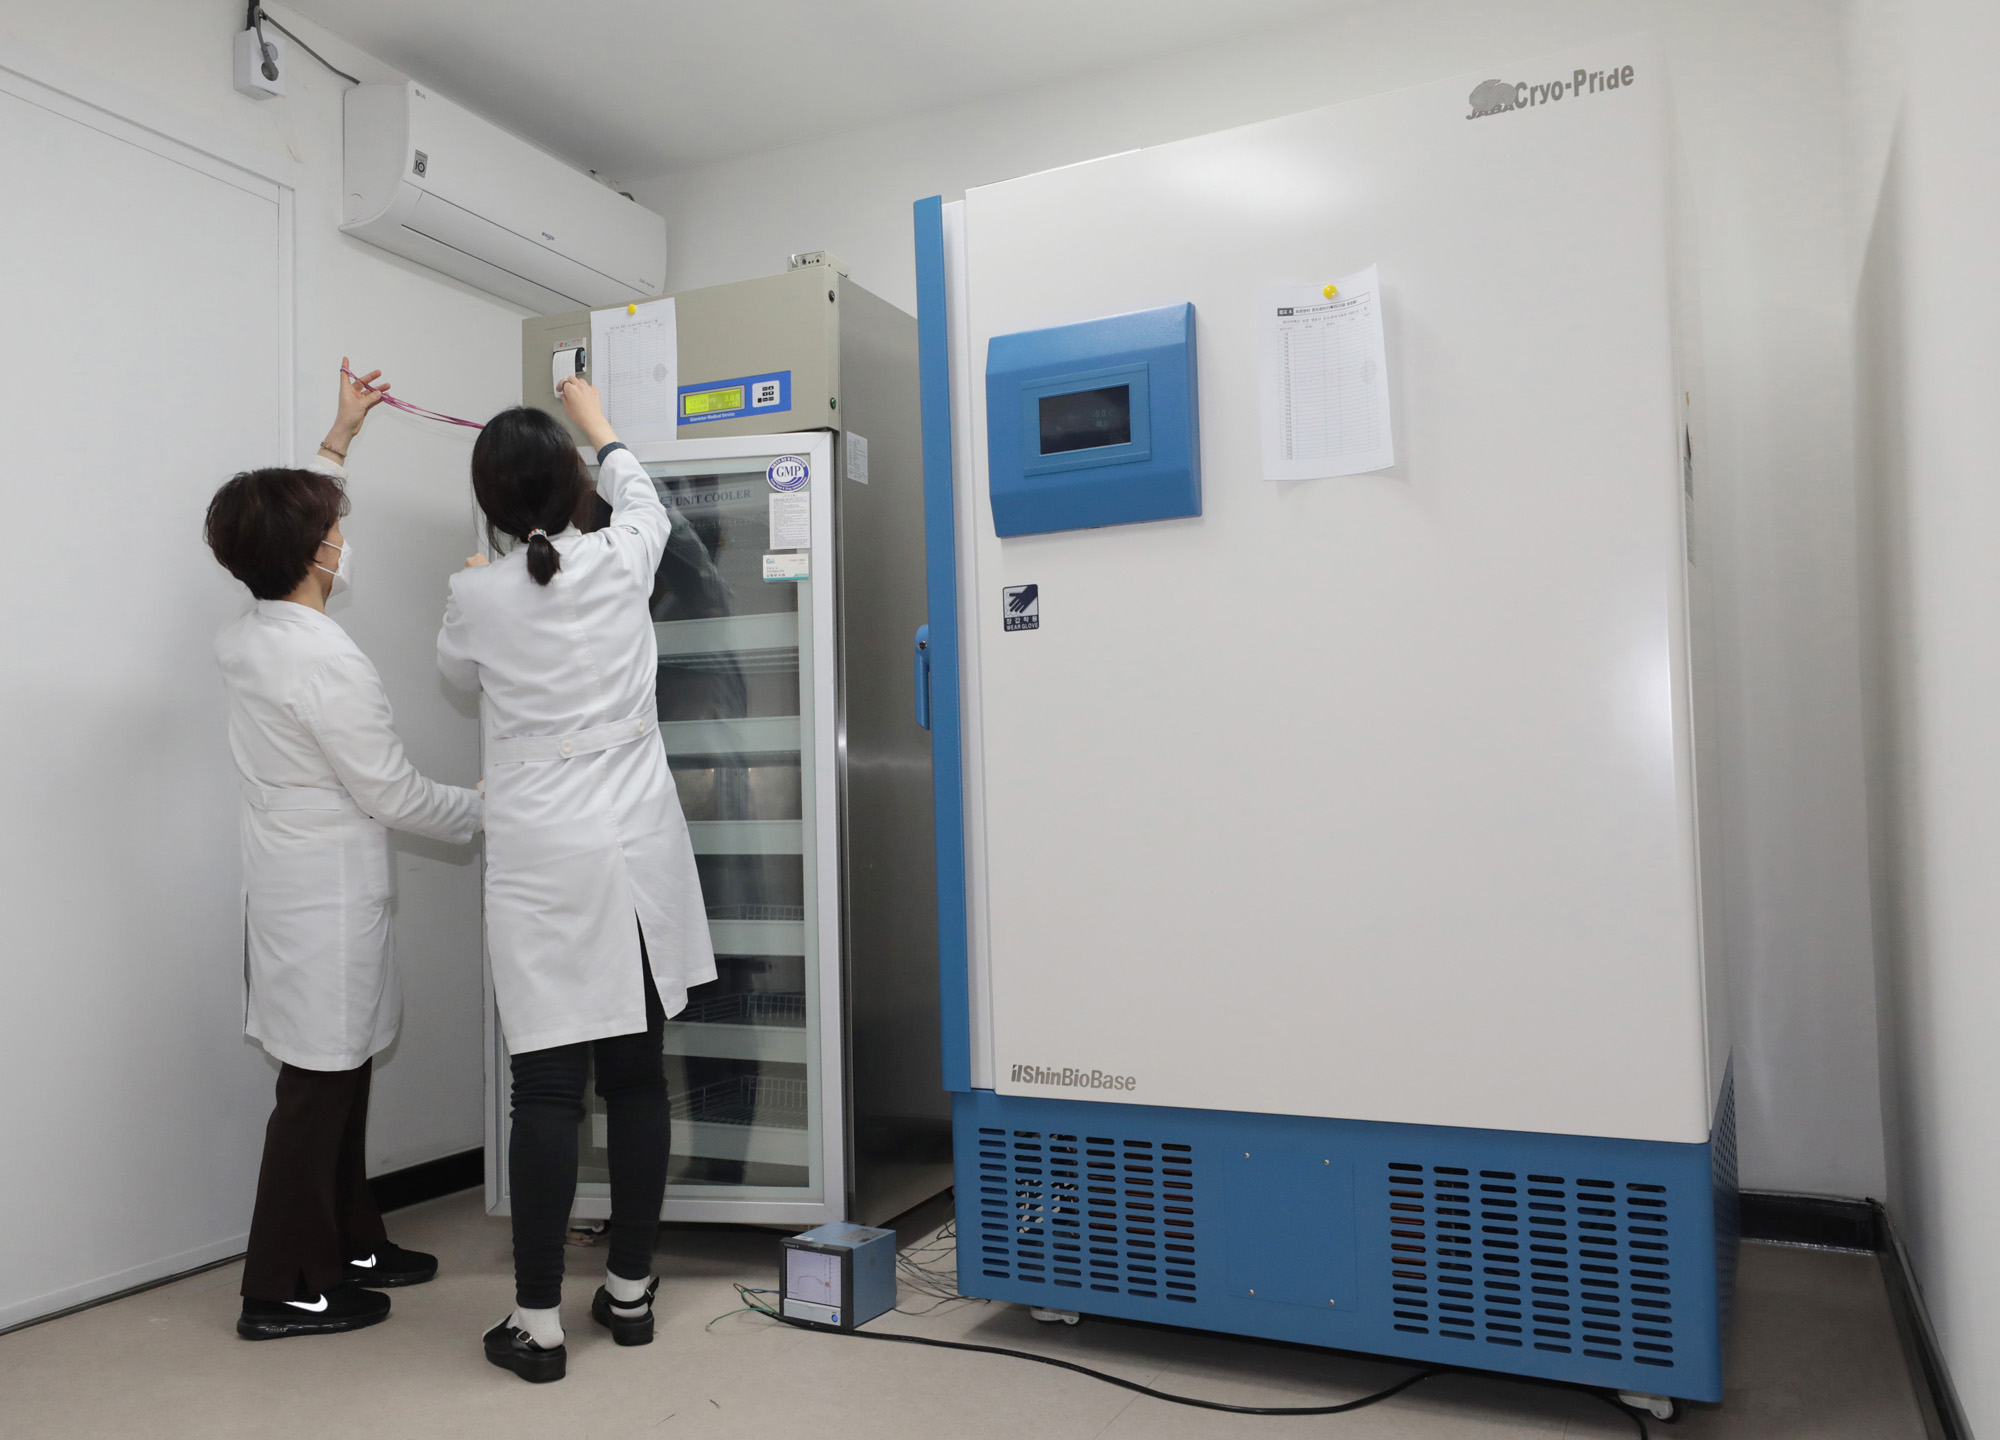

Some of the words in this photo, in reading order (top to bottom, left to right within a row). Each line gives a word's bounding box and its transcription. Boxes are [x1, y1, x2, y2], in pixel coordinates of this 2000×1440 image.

[1514, 64, 1635, 109] Cryo-Pride
[776, 465, 801, 477] GMP
[675, 494, 702, 506] UNIT
[704, 489, 751, 503] COOLER
[1006, 623, 1021, 631] WEAR
[1021, 622, 1038, 630] GLOVE
